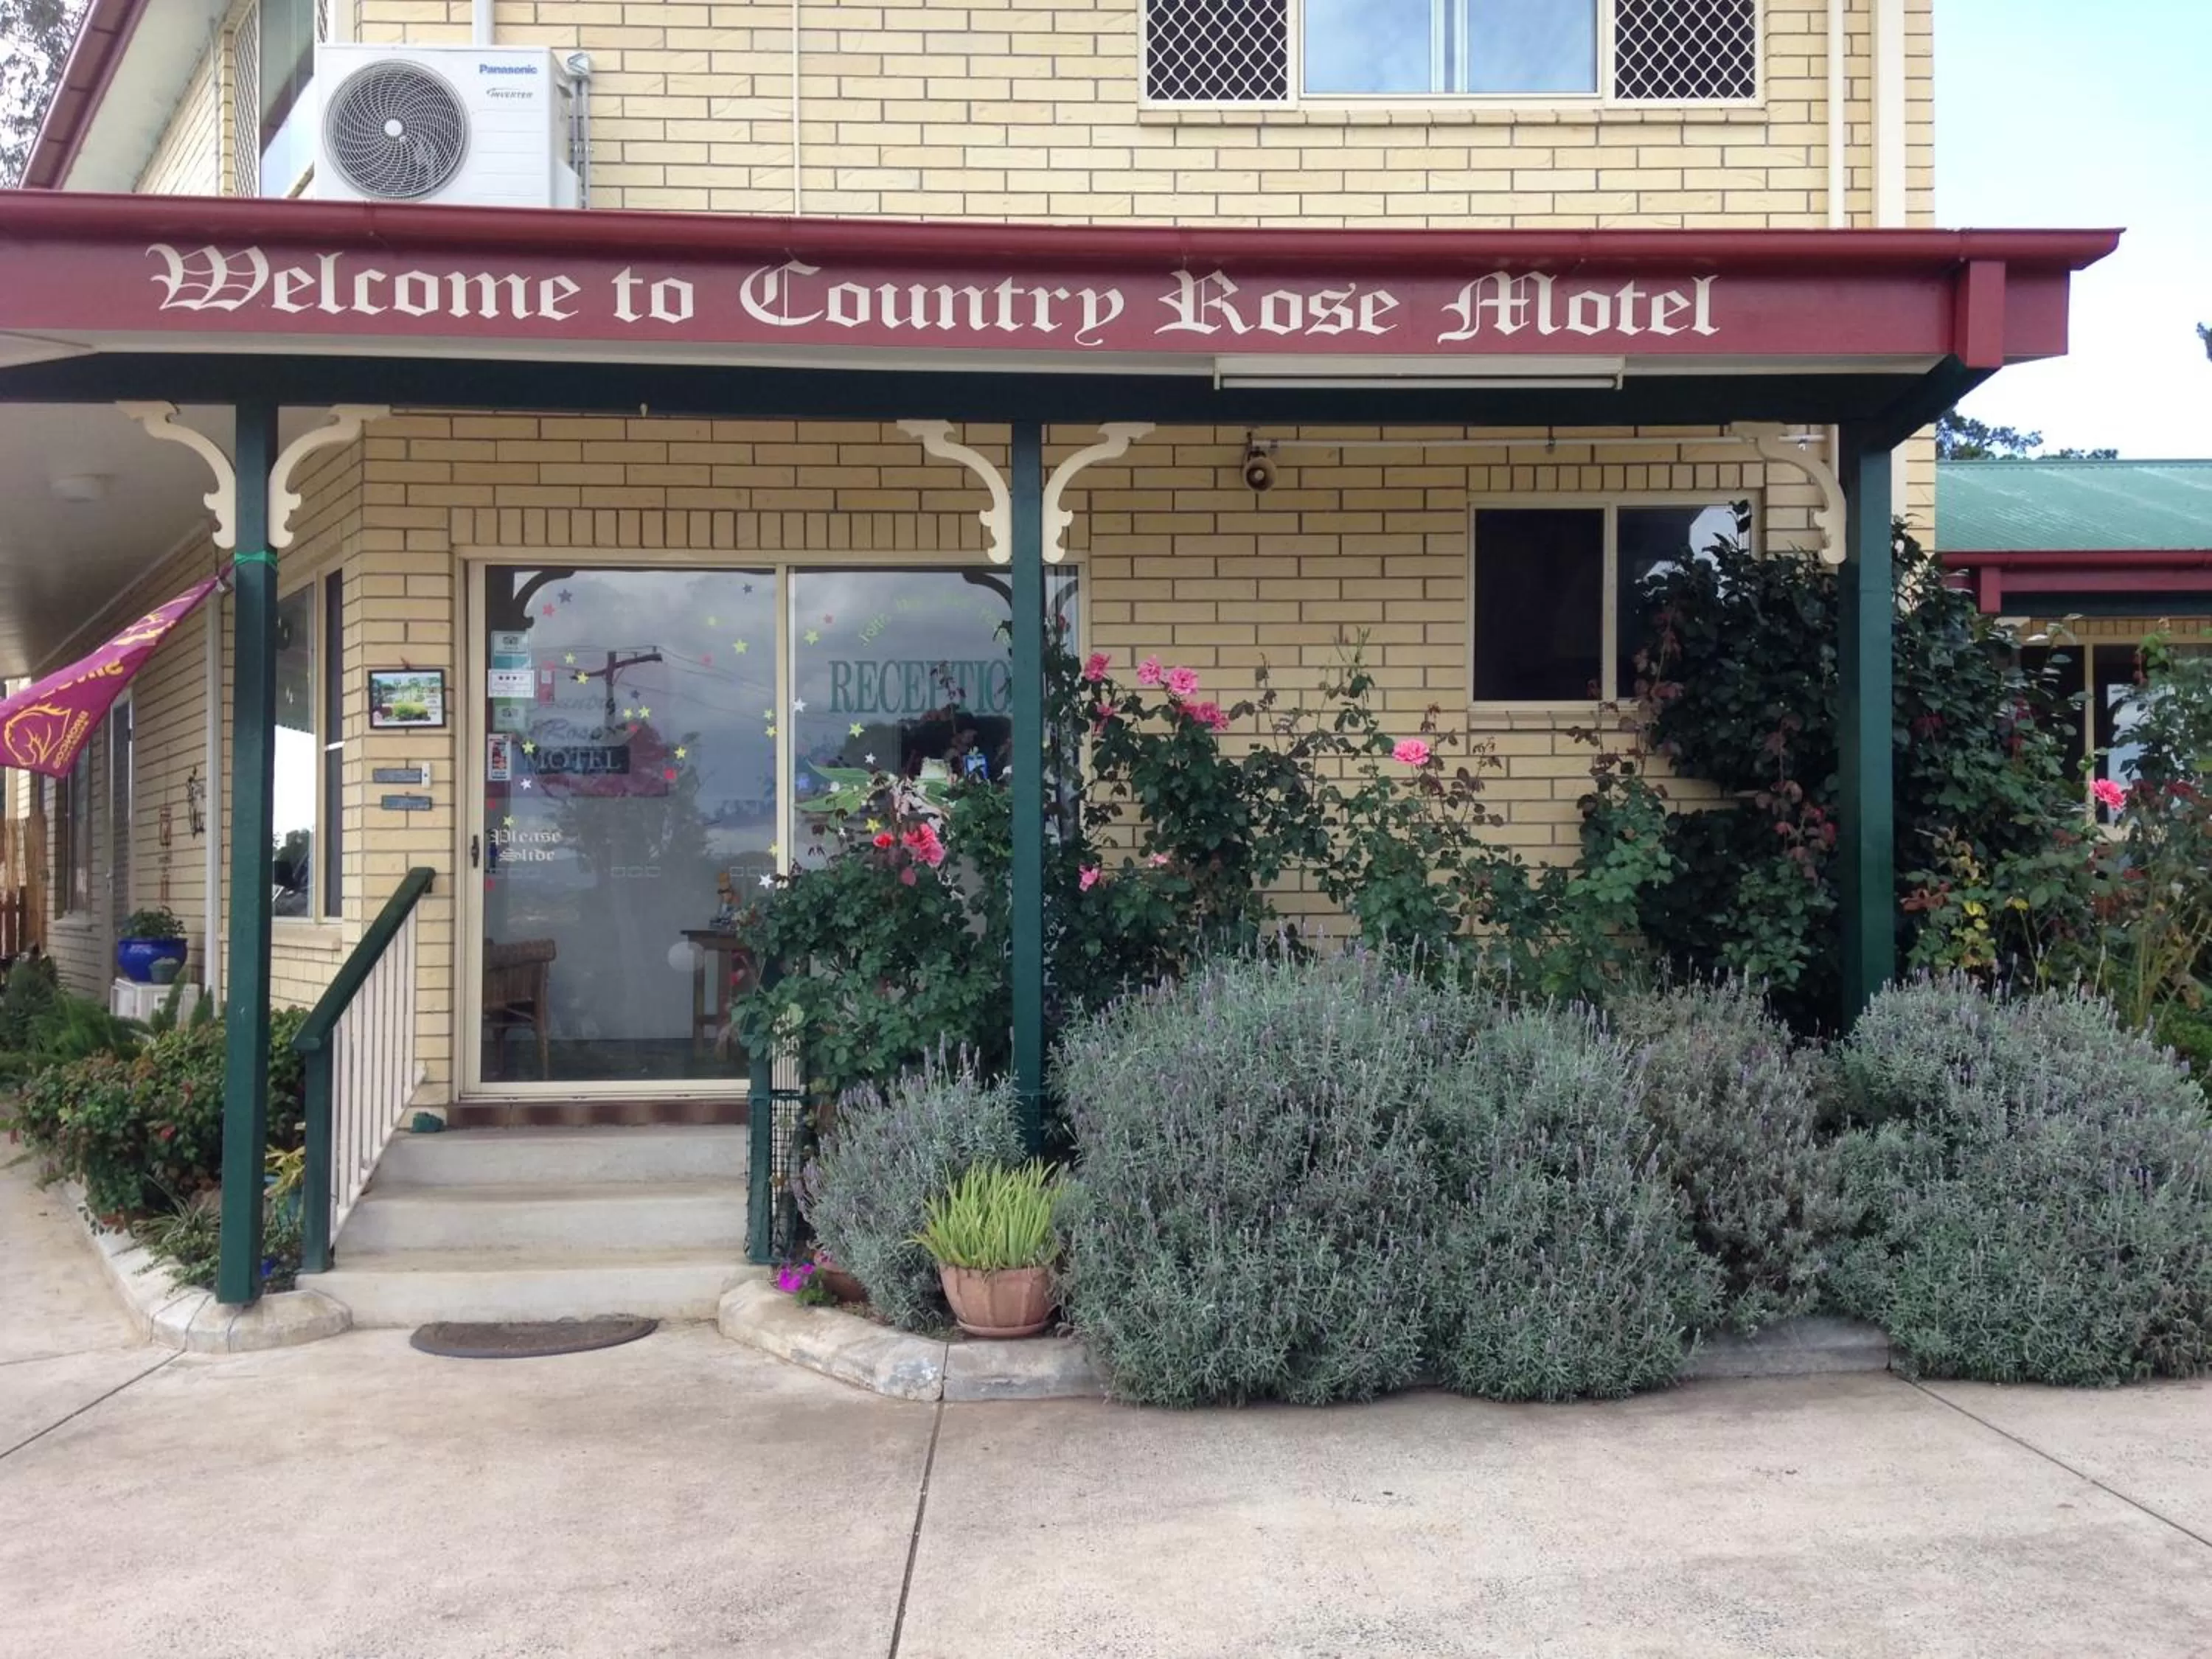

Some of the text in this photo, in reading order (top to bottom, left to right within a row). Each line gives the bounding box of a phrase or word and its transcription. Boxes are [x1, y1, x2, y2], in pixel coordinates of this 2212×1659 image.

[479, 63, 538, 74] Panasonic
[145, 243, 1721, 346] Welcome to Country Rose Motel
[828, 658, 1014, 714] RECEPTIO
[524, 748, 622, 770] MOTEL
[490, 828, 563, 846] Please
[498, 849, 554, 862] Slide
